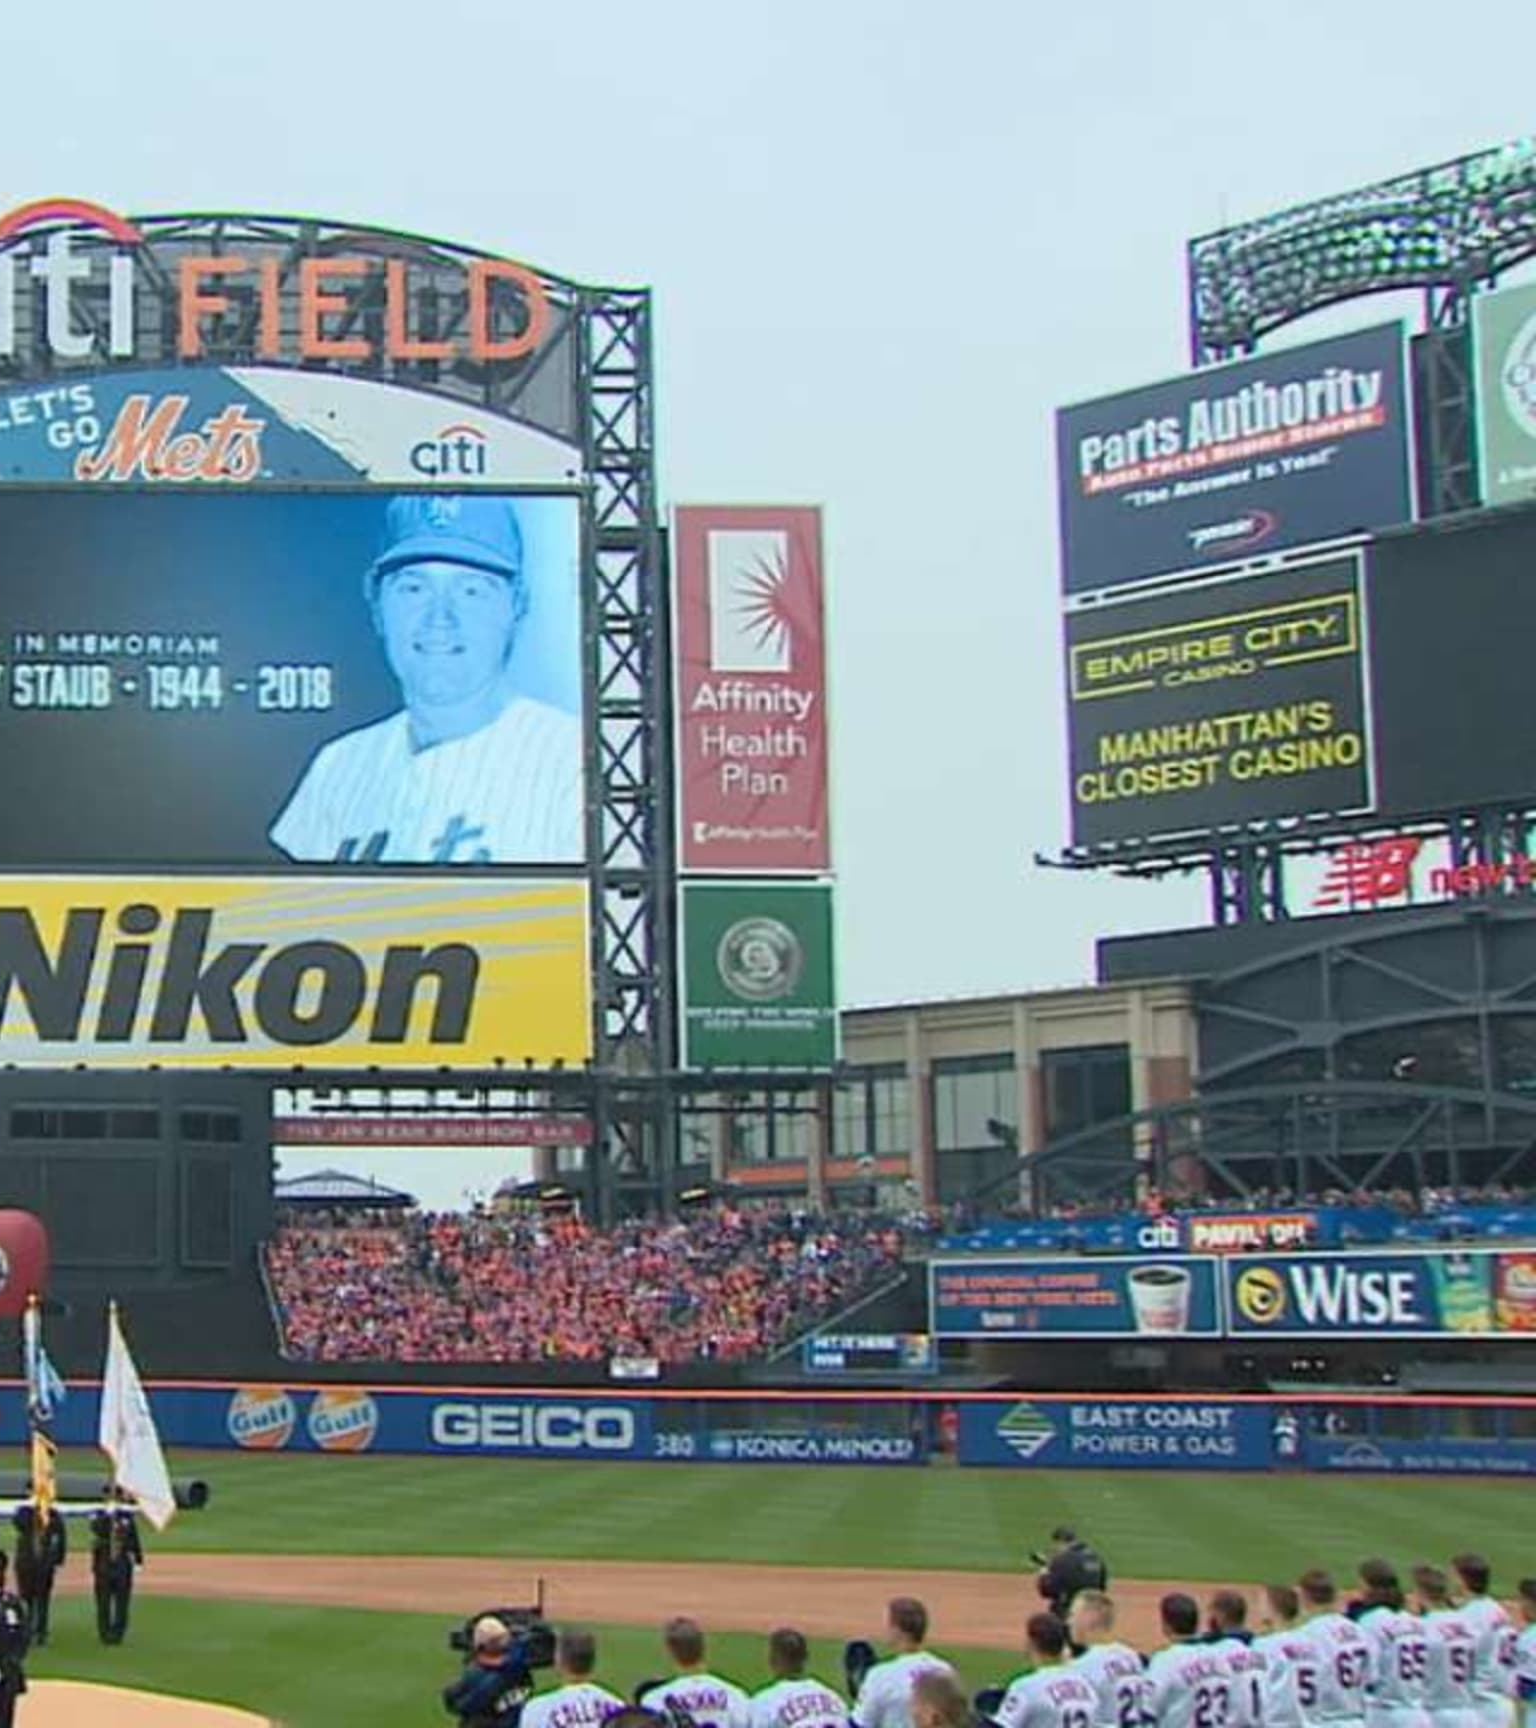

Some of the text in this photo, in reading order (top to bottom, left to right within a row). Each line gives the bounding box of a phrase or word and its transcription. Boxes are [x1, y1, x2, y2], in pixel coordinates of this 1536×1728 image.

[177, 257, 548, 361] FIELD
[47, 421, 100, 451] GO
[75, 396, 266, 482] Mets
[1080, 367, 1383, 476] Parts Authority
[410, 440, 486, 475] citi
[16, 635, 219, 653] IN MEMORIAM
[1085, 615, 1337, 681] EMPIRE CITY
[14, 664, 110, 707] STAUB
[150, 665, 222, 707] 1944
[258, 664, 331, 708] 2018
[1163, 659, 1255, 687] CASINO
[692, 681, 814, 721] Affinity
[700, 725, 807, 757] Health
[1098, 700, 1332, 766] MANHATTAN'S
[721, 763, 789, 796] Plan
[1075, 734, 1361, 803] CLOSEST CASINO
[1289, 1264, 1424, 1324] WISE
[233, 1403, 289, 1433] Gulf
[313, 1403, 373, 1434] Gulf
[431, 1403, 635, 1449] GEICO
[1070, 1406, 1233, 1428] EAST COAST
[655, 1435, 695, 1457] 380
[737, 1438, 915, 1460] KONICA MINOLTA
[1072, 1435, 1161, 1453] POWER
[1187, 1436, 1237, 1456] GAS
[1297, 1668, 1316, 1707] 5
[1336, 1649, 1367, 1689] 67
